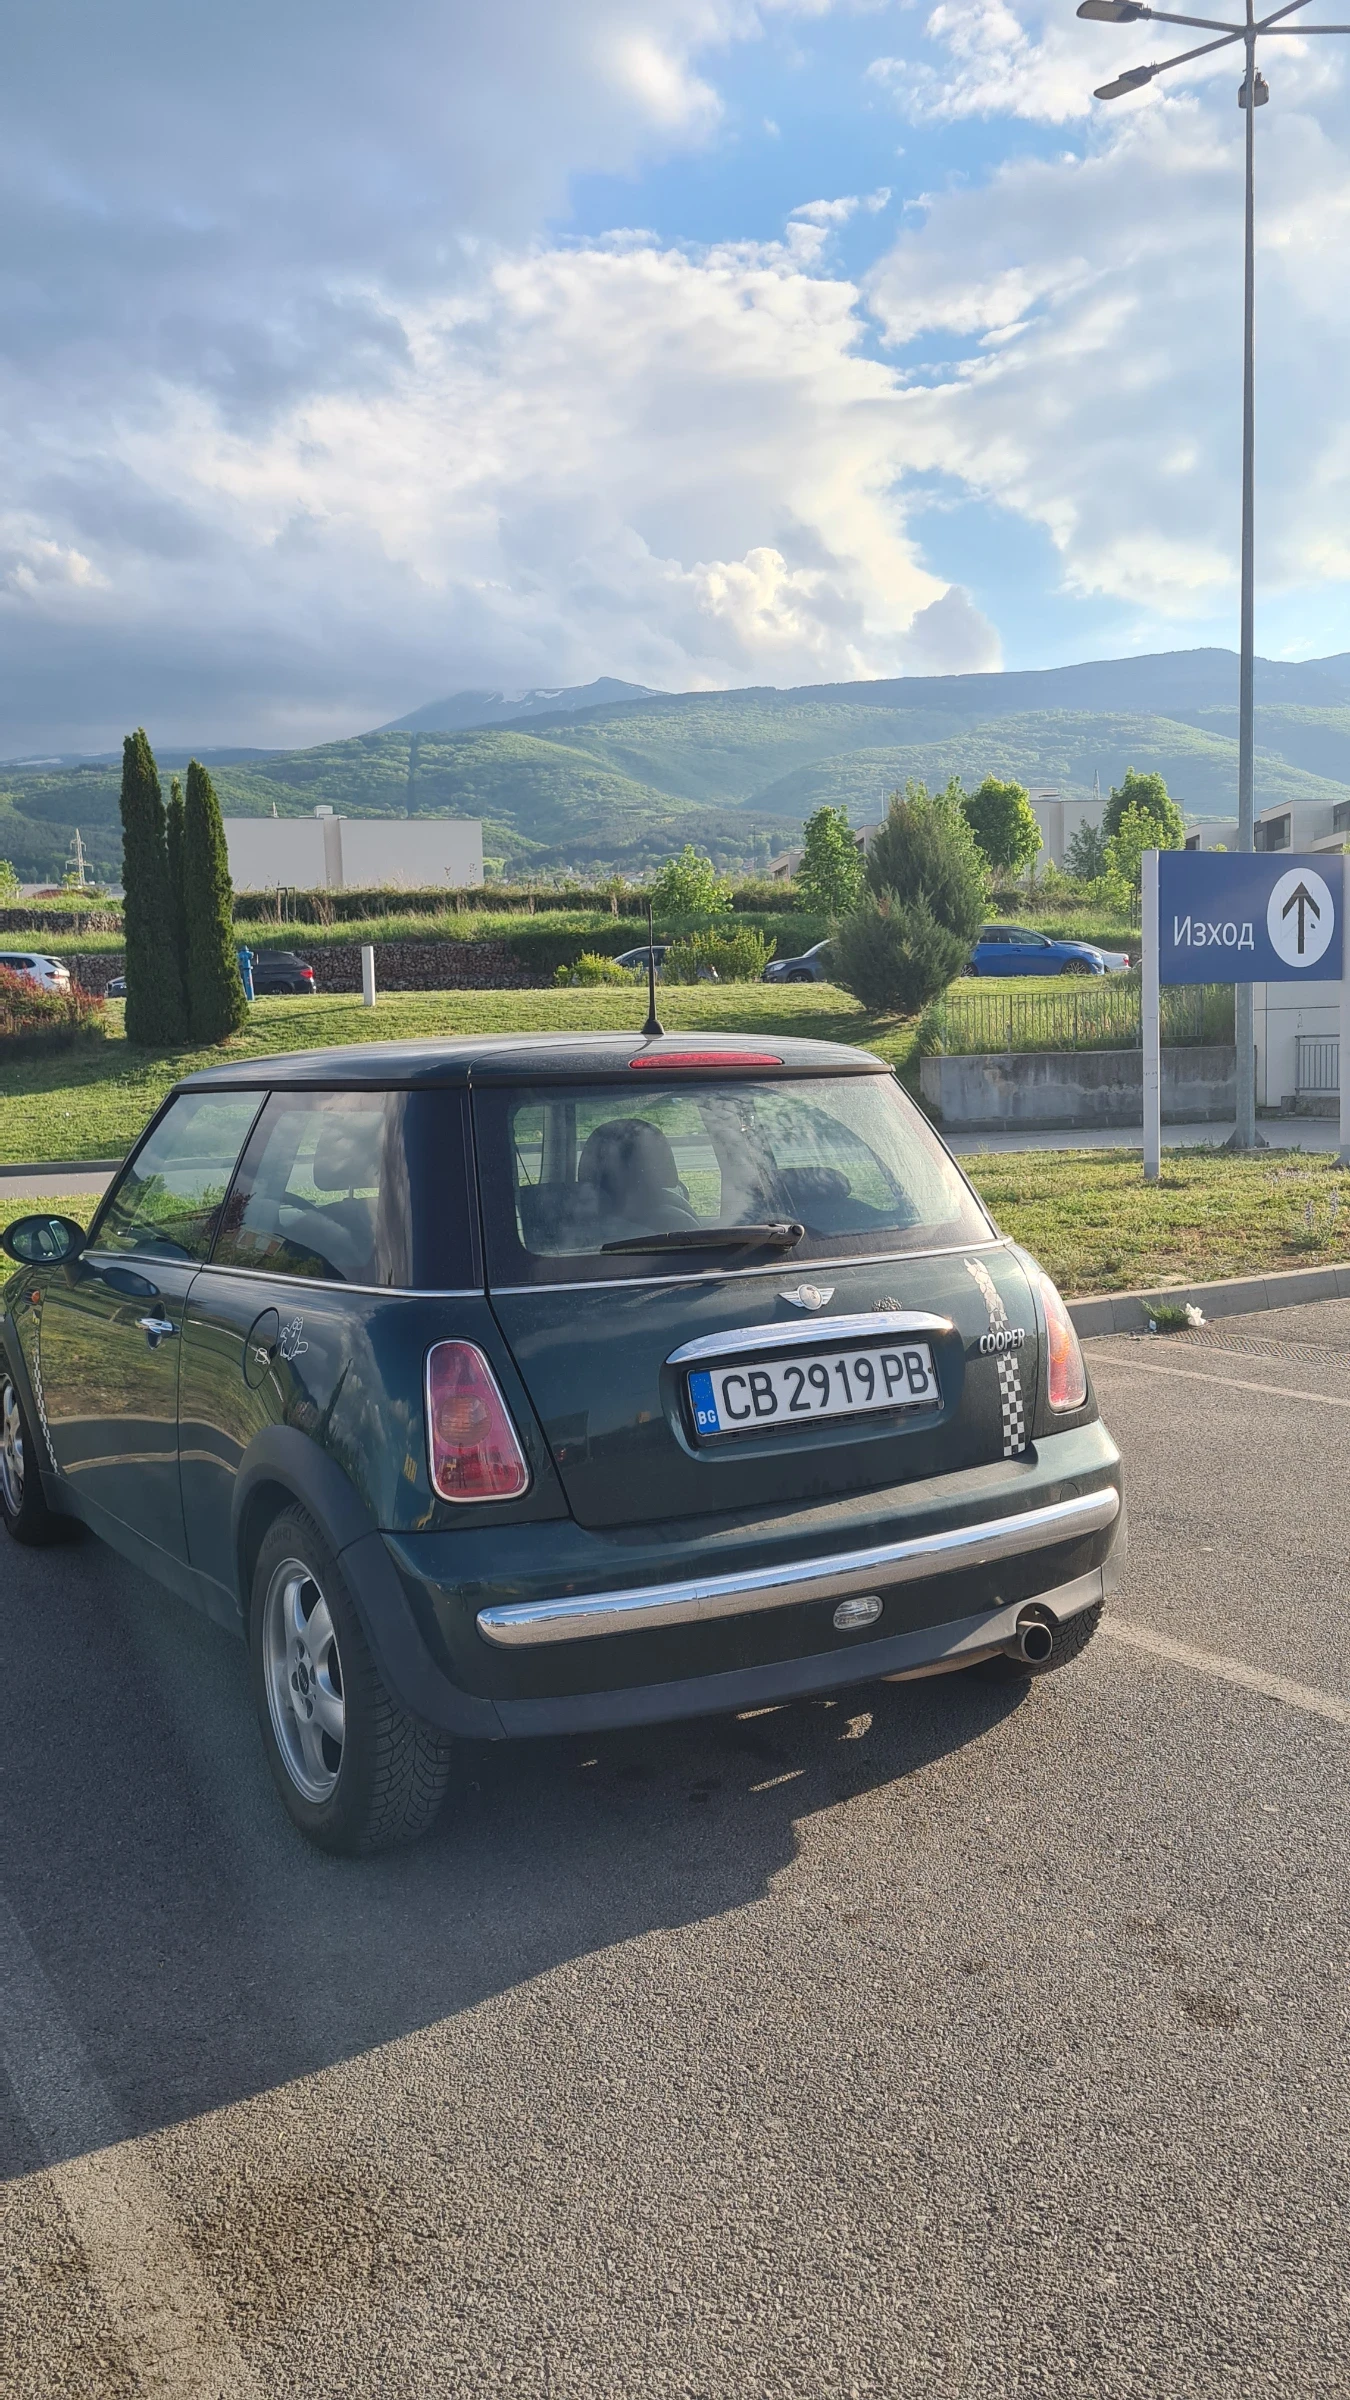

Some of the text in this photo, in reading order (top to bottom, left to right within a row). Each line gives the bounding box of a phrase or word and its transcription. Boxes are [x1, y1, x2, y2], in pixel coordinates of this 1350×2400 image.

[1174, 916, 1254, 950] Изход
[980, 1328, 1025, 1354] COOPER
[784, 1358, 875, 1411] 2919
[698, 1410, 716, 1425] BG
